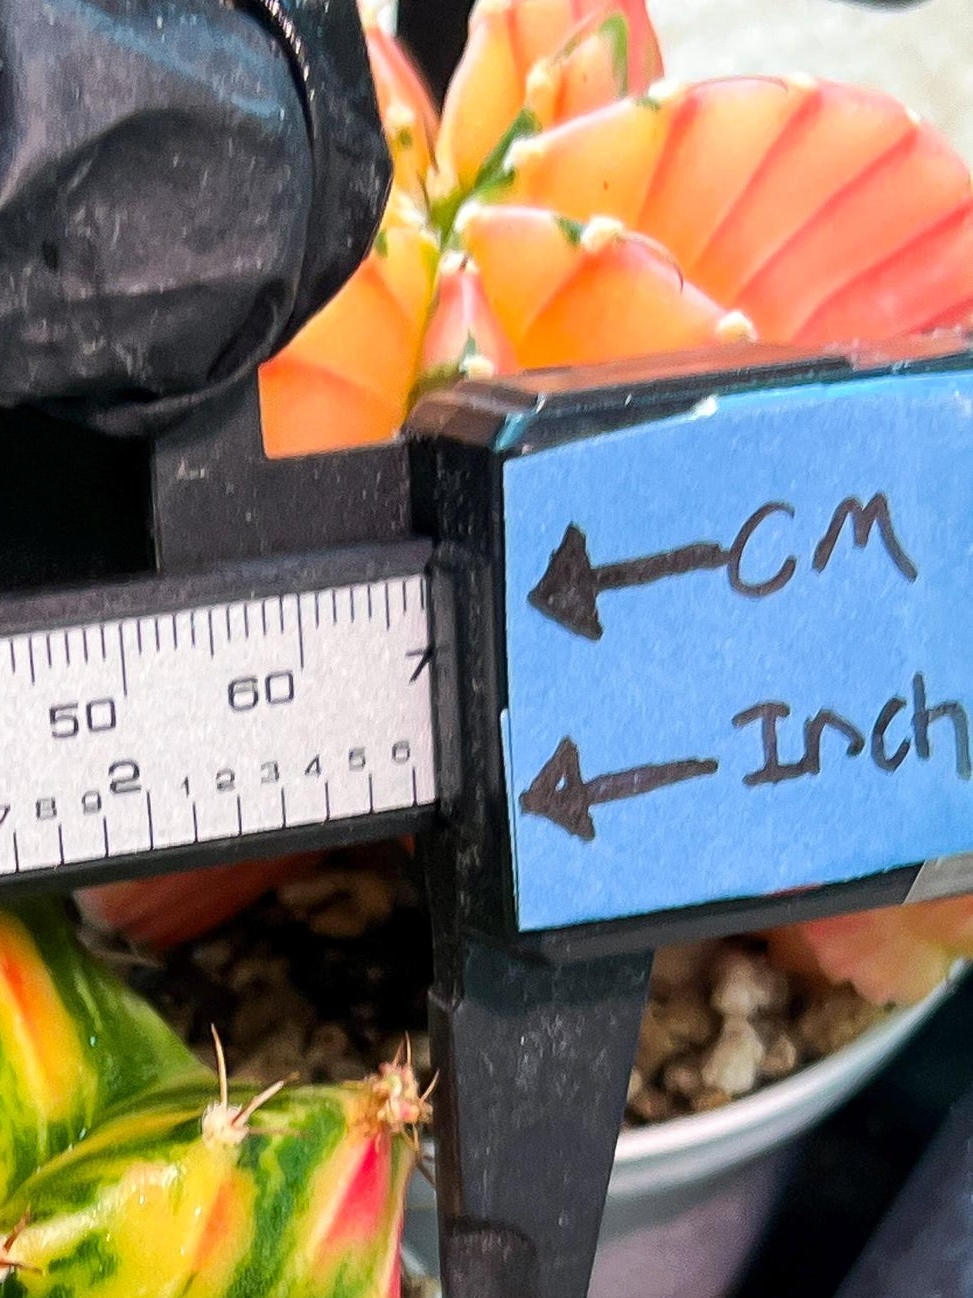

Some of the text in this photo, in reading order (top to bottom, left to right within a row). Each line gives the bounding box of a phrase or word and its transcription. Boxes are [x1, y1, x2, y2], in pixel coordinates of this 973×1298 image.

[727, 491, 918, 599] CM
[49, 697, 117, 738] 50
[228, 669, 295, 712] 60
[731, 669, 972, 788] Inch
[36, 797, 57, 820] 8
[108, 759, 142, 794] 2
[181, 775, 190, 797] 1
[216, 768, 236, 792] 2
[260, 760, 280, 784] 3
[304, 754, 322, 778] 4
[349, 746, 366, 771] 5
[391, 740, 411, 764] 6
